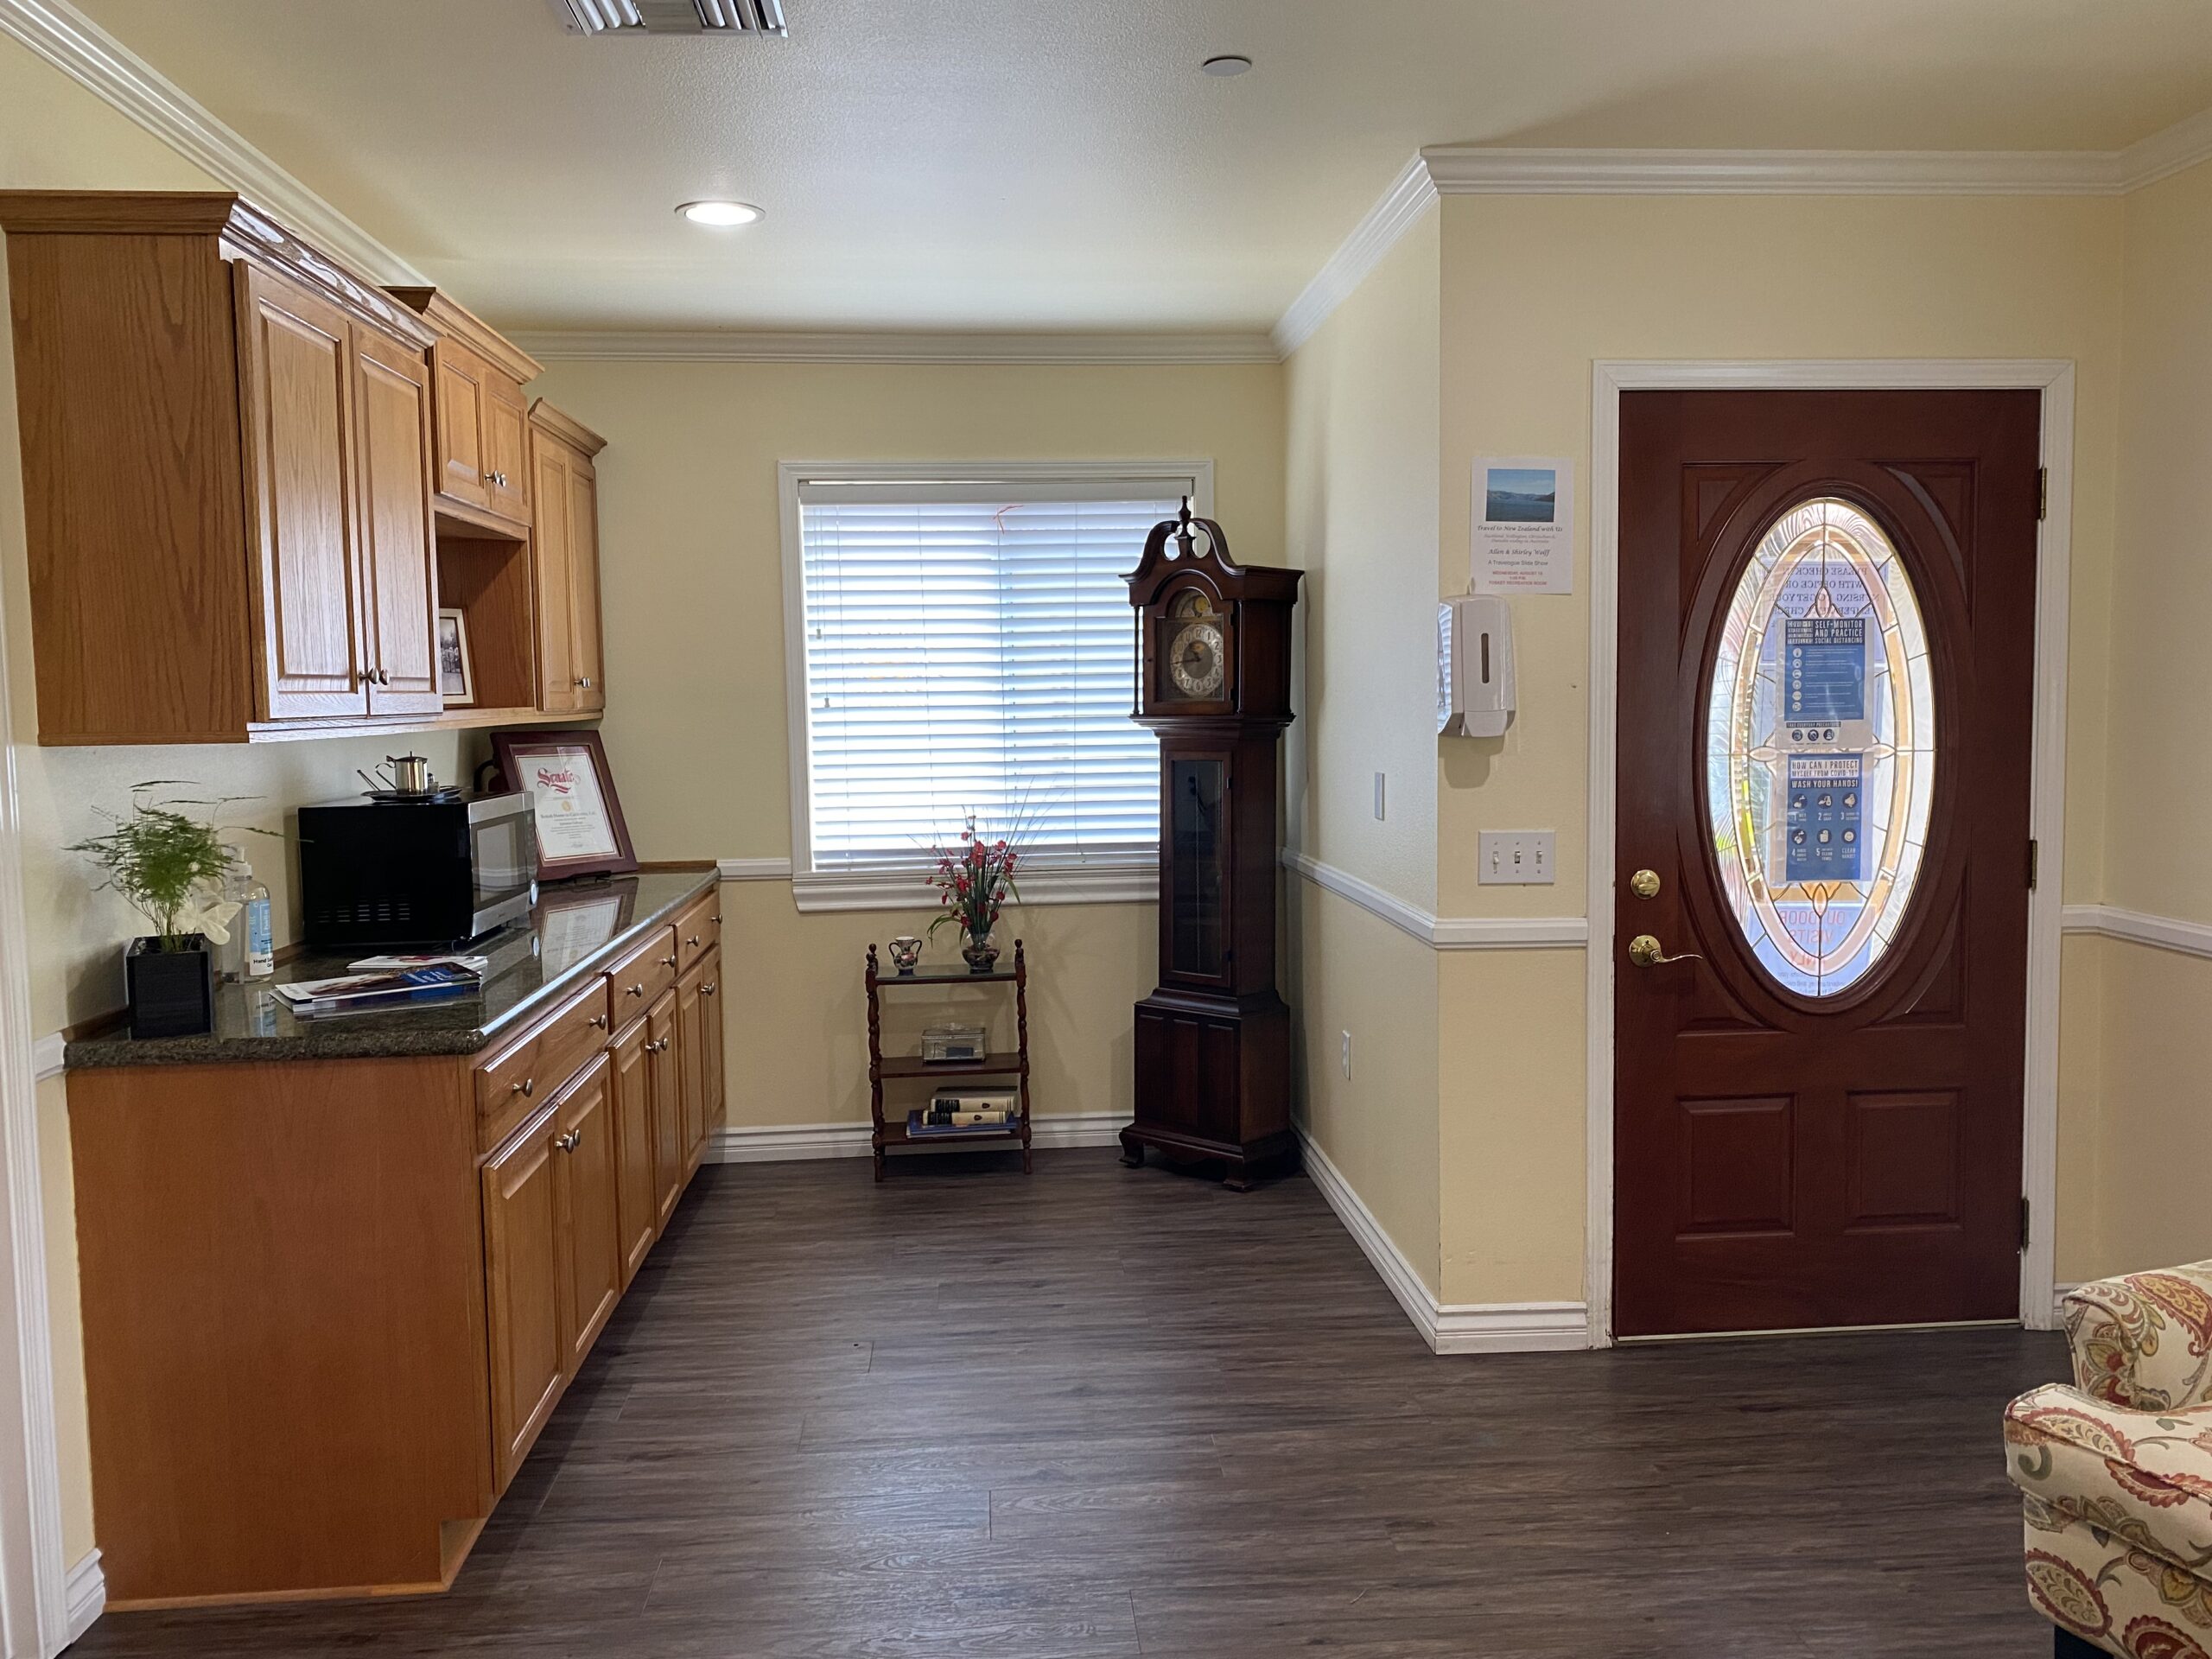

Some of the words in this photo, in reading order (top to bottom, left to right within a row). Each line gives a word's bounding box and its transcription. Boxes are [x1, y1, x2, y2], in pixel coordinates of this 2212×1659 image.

[1831, 628, 1862, 637] PRACTICE
[1792, 761, 1807, 770] HOW
[1830, 760, 1858, 769] PROTECT
[1817, 812, 1822, 821] 2
[1816, 848, 1821, 856] 5
